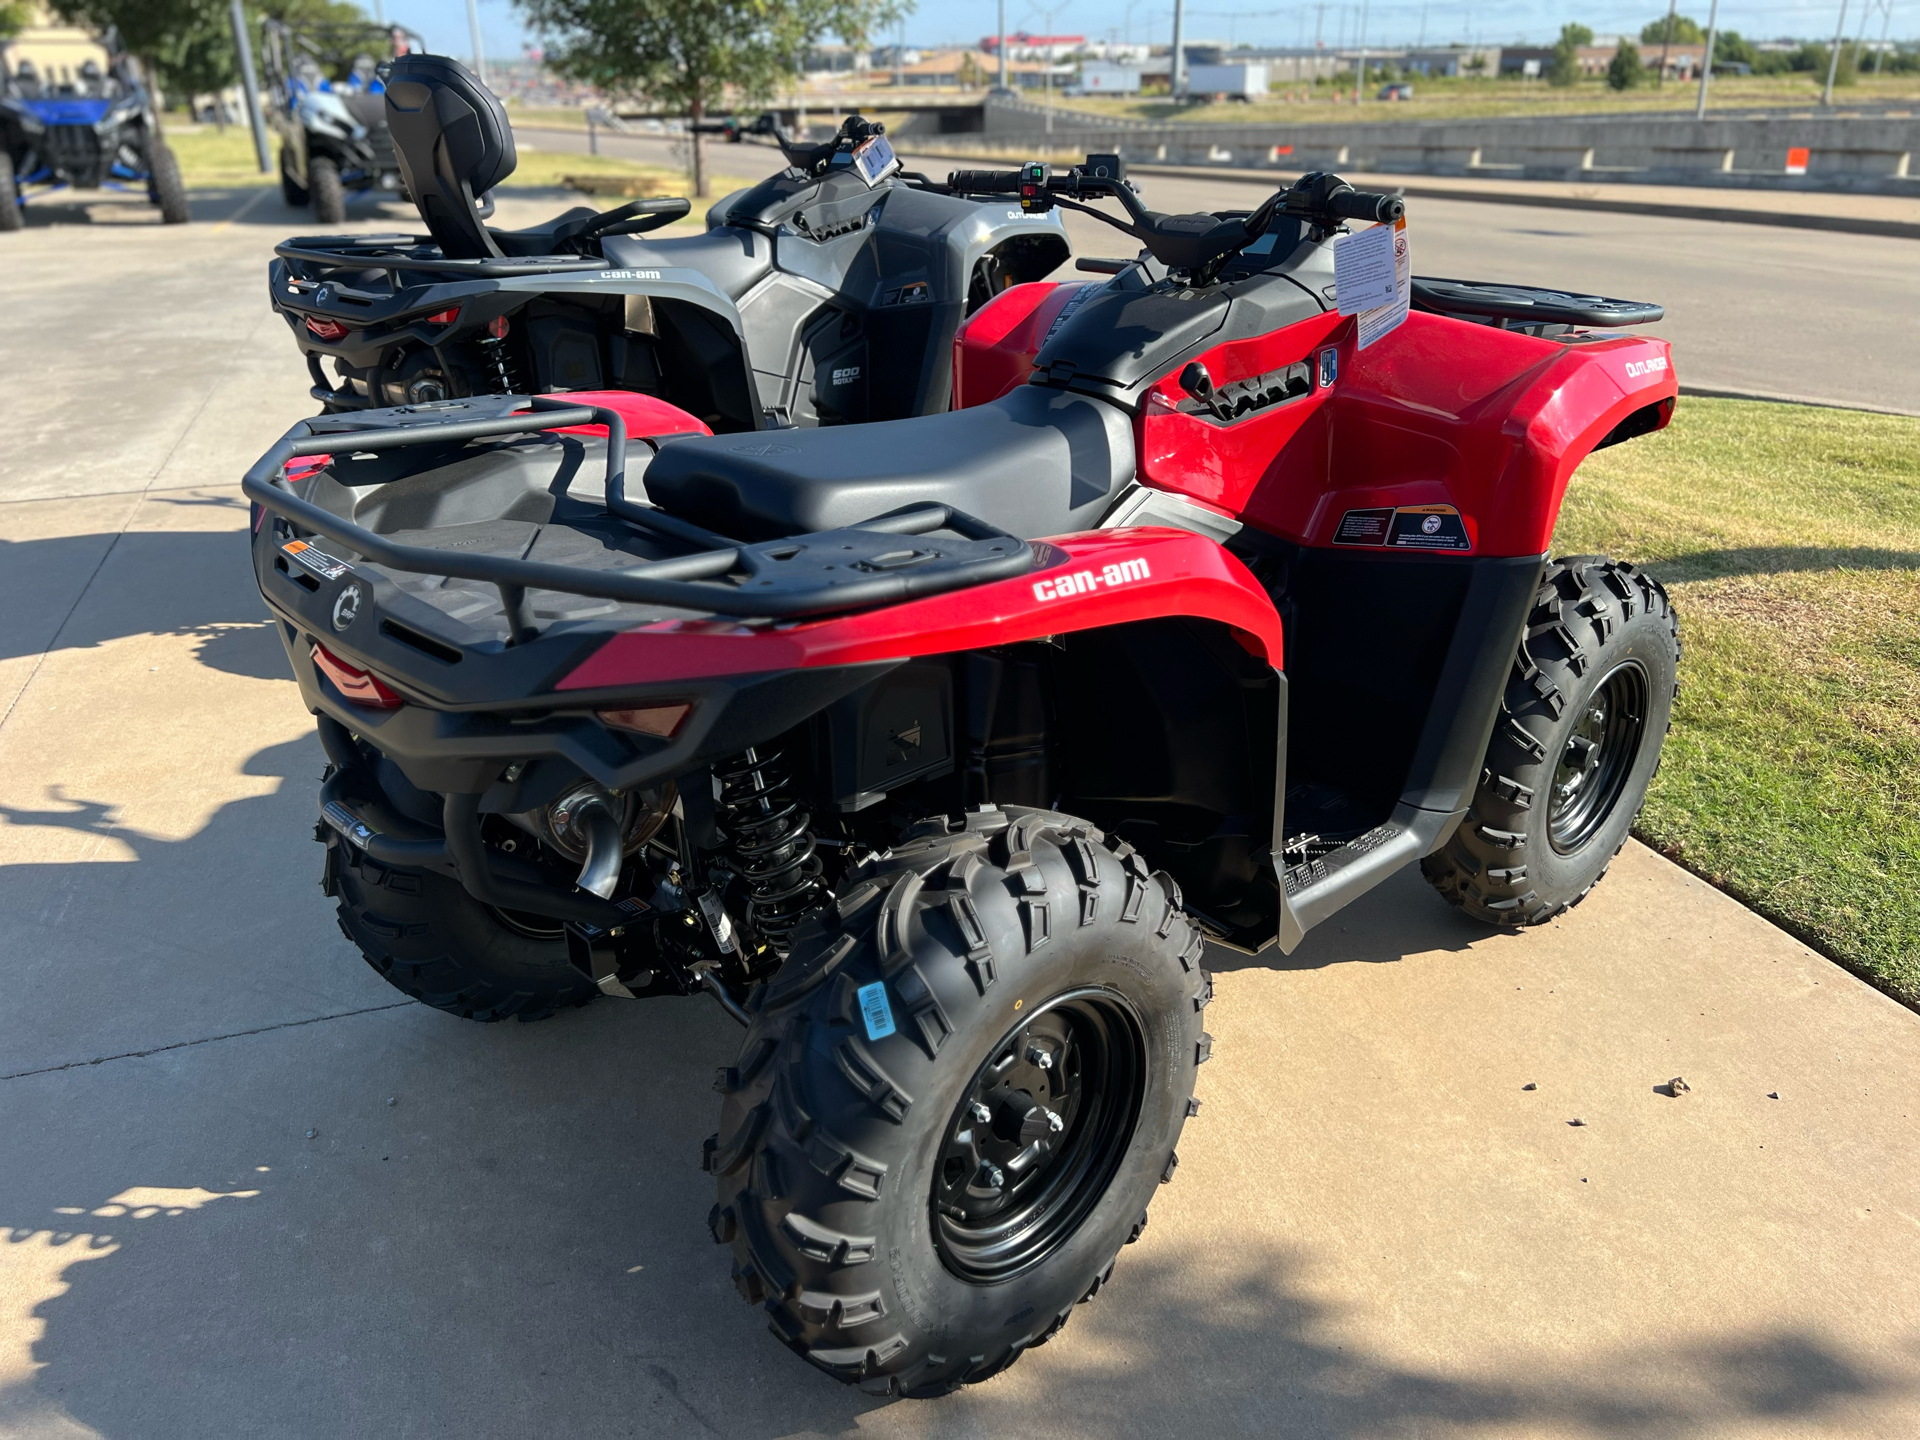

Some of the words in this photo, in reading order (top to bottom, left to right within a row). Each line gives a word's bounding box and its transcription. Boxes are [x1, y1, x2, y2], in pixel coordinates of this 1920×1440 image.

[600, 270, 661, 280] can-am
[832, 366, 860, 379] 500
[1625, 356, 1668, 378] OUTLANDER
[833, 377, 854, 386] ROTAX
[1032, 557, 1151, 602] can-am
[340, 608, 356, 620] BRP
